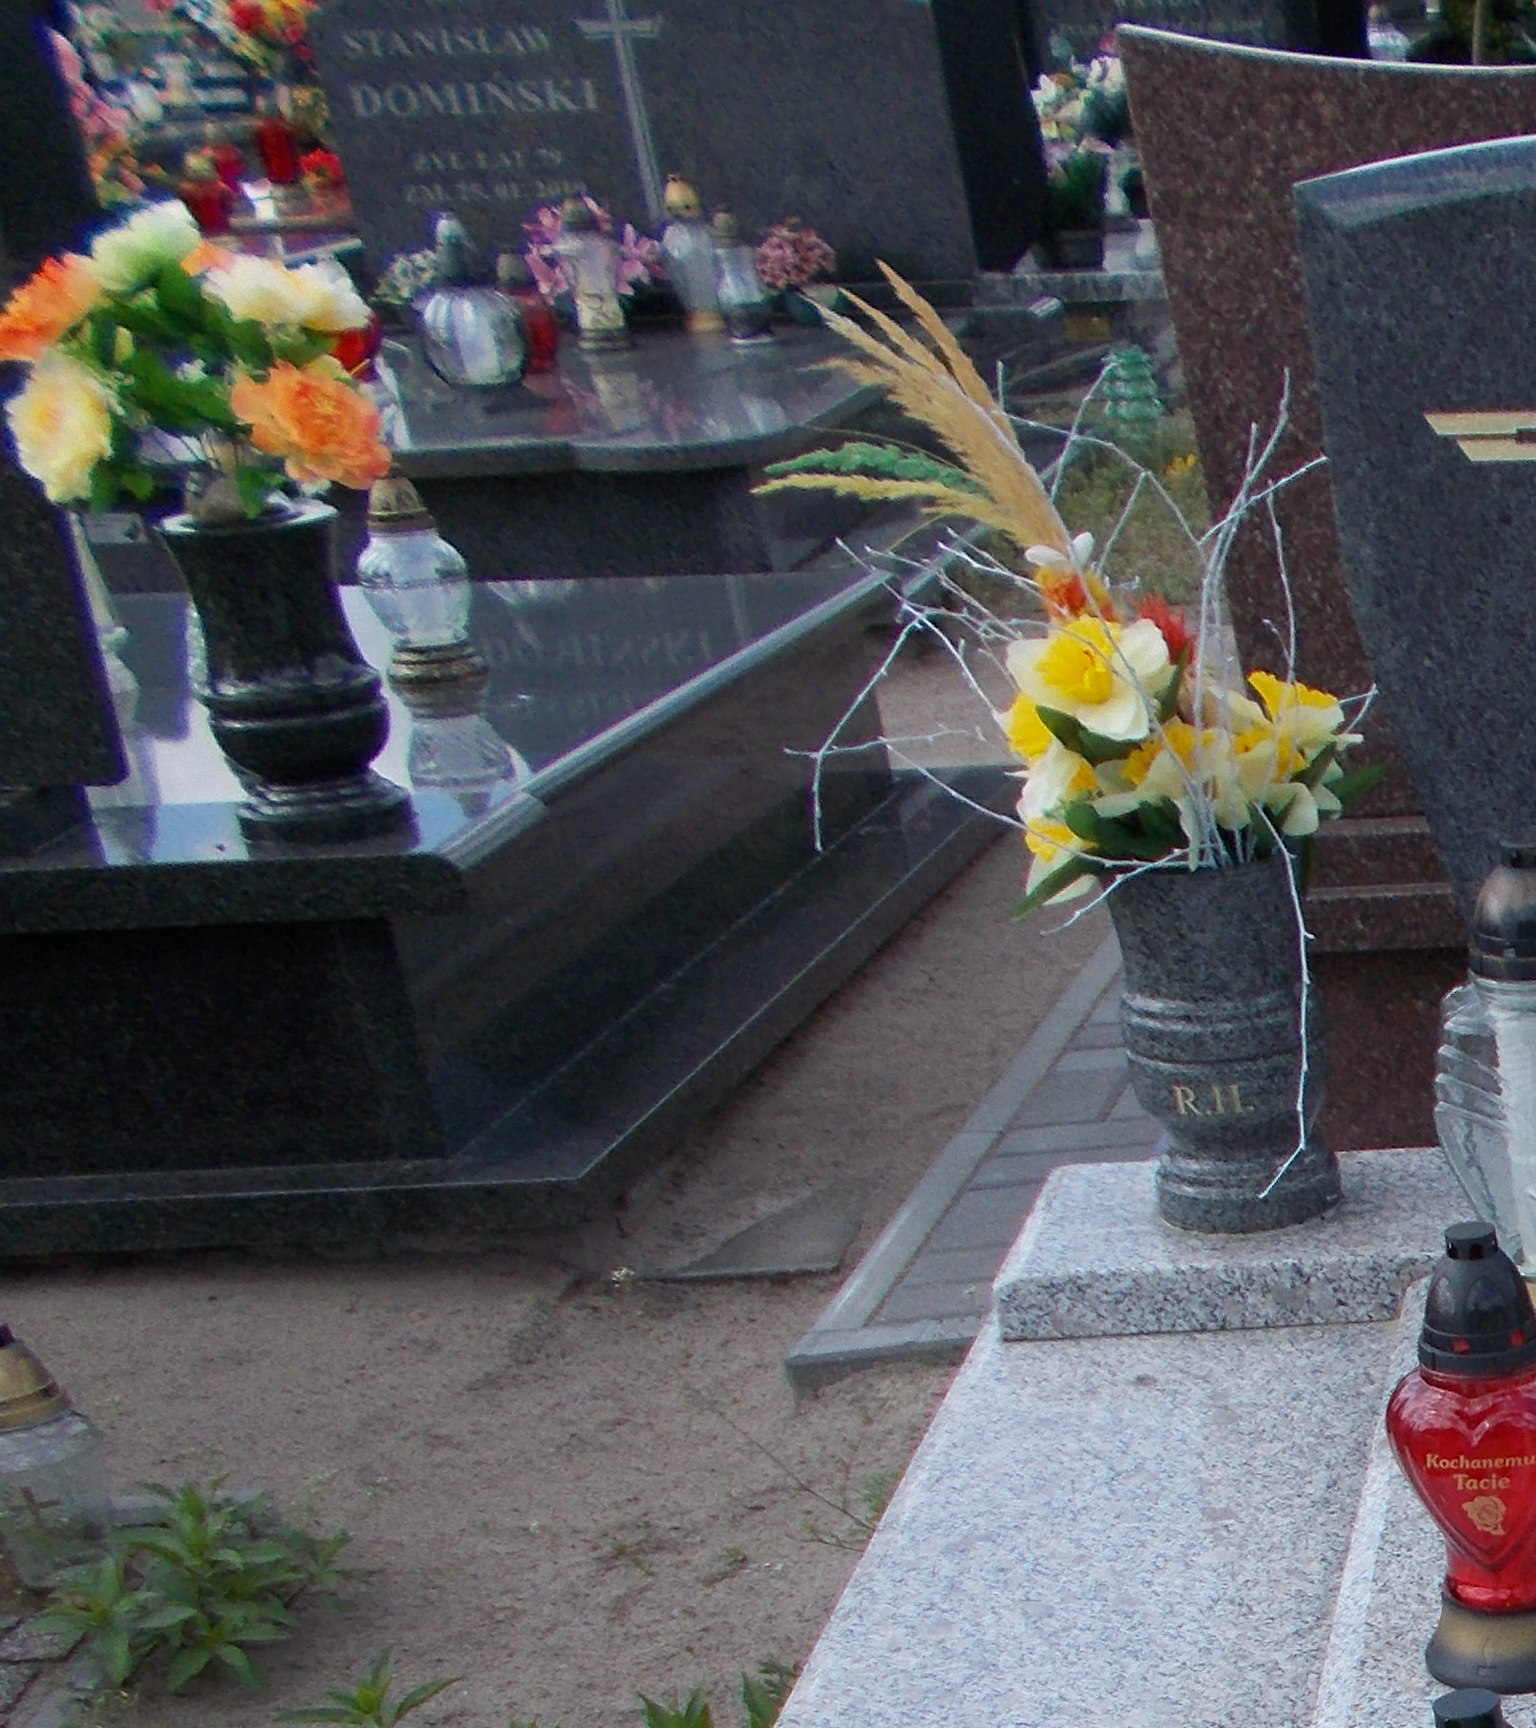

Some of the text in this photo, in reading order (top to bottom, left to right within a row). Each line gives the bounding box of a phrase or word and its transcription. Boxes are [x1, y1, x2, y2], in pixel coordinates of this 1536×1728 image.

[351, 70, 600, 118] DOMIŃSKI
[1425, 1453, 1536, 1470] Kochanemu
[1452, 1473, 1511, 1491] Tacie
